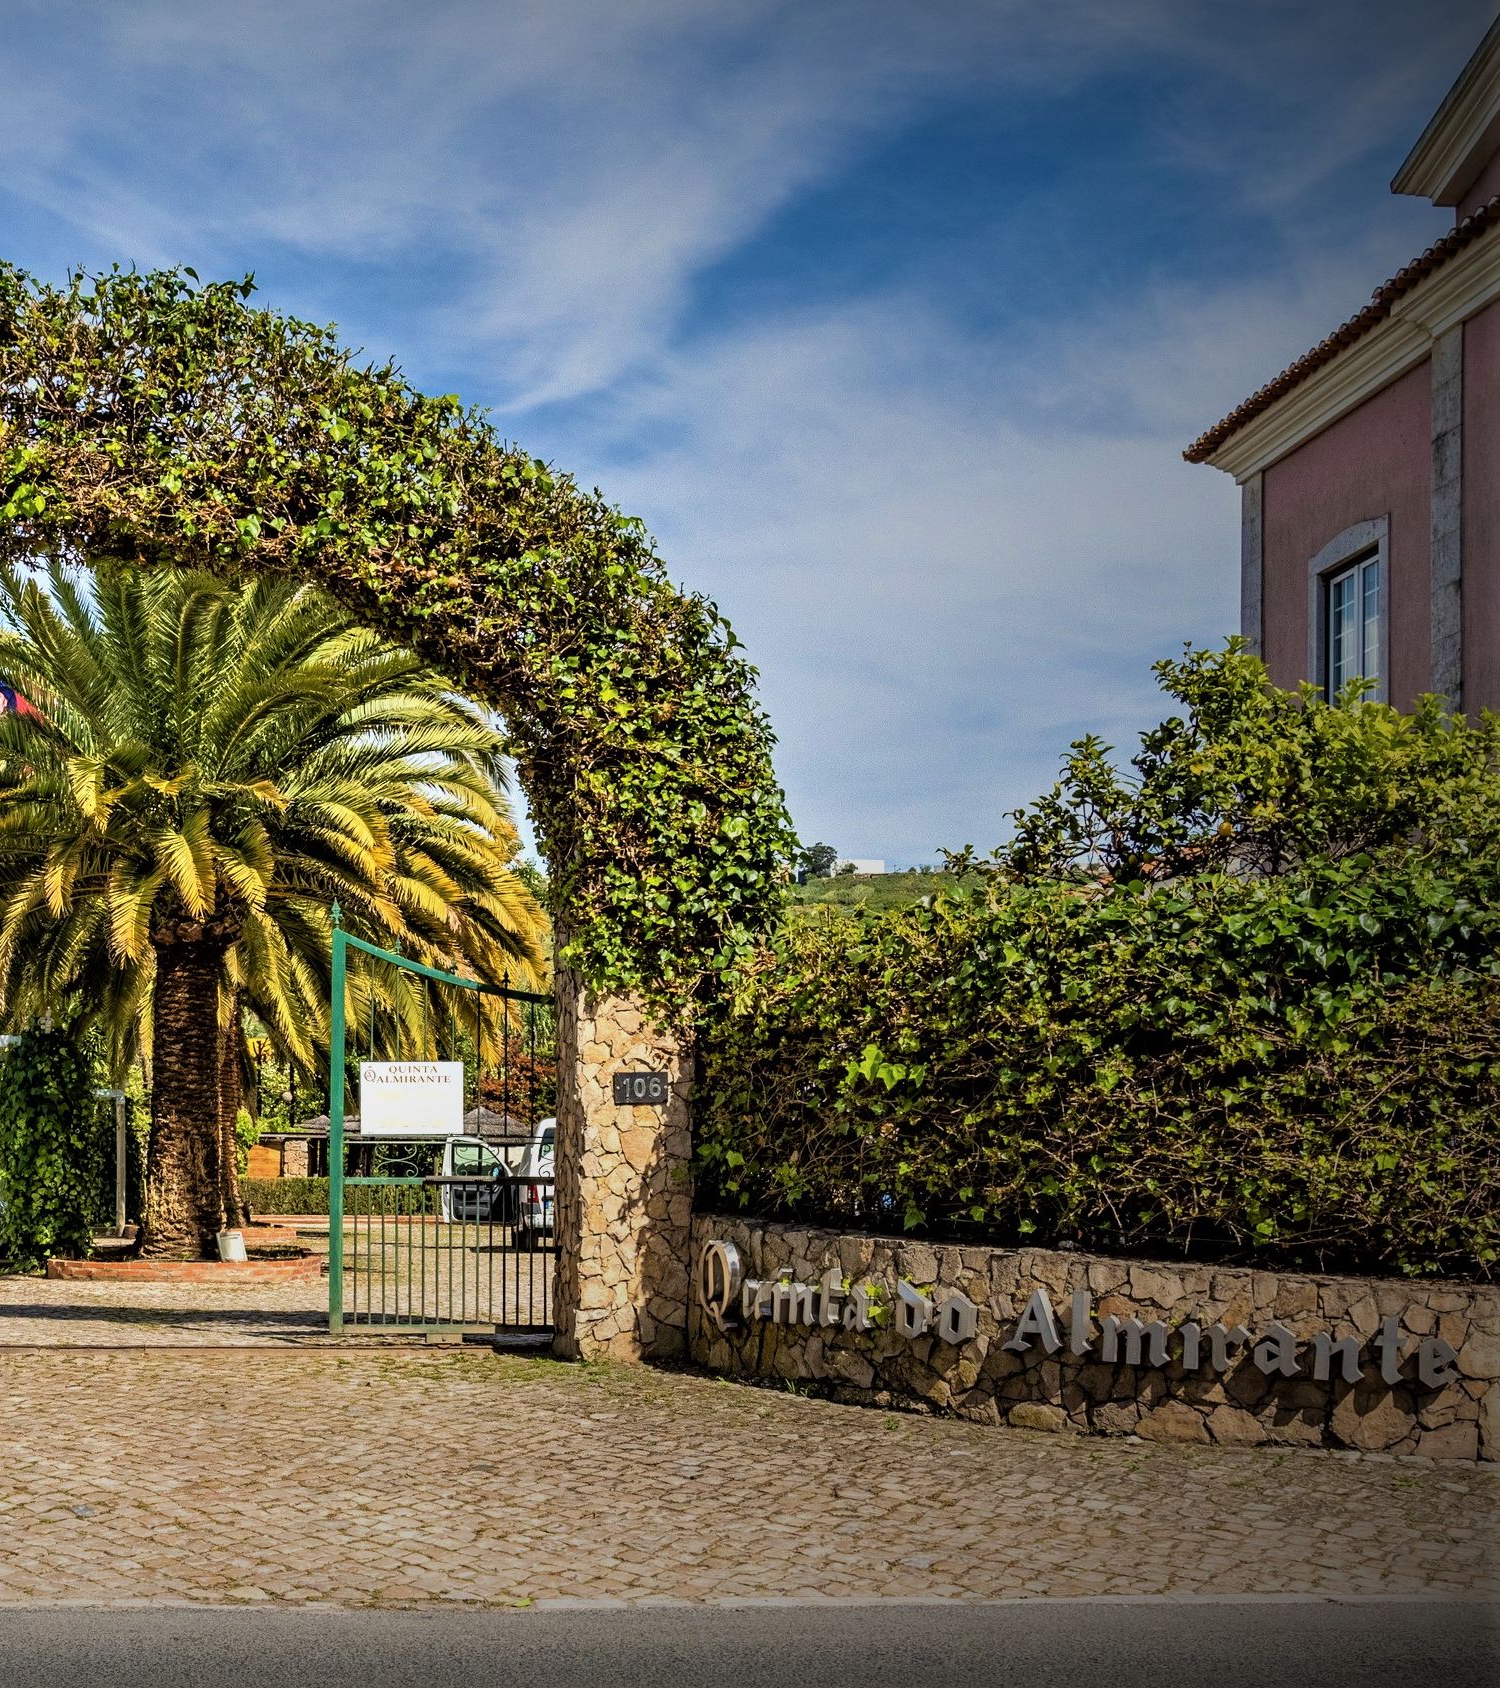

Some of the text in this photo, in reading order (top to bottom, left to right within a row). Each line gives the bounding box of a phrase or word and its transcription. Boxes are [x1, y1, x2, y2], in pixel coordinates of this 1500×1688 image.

[388, 1065, 438, 1074] QUINTA
[376, 1075, 451, 1083] ALMIRANTE
[623, 1077, 662, 1098] 106
[700, 1239, 1460, 1389] Quinta do Almirante
